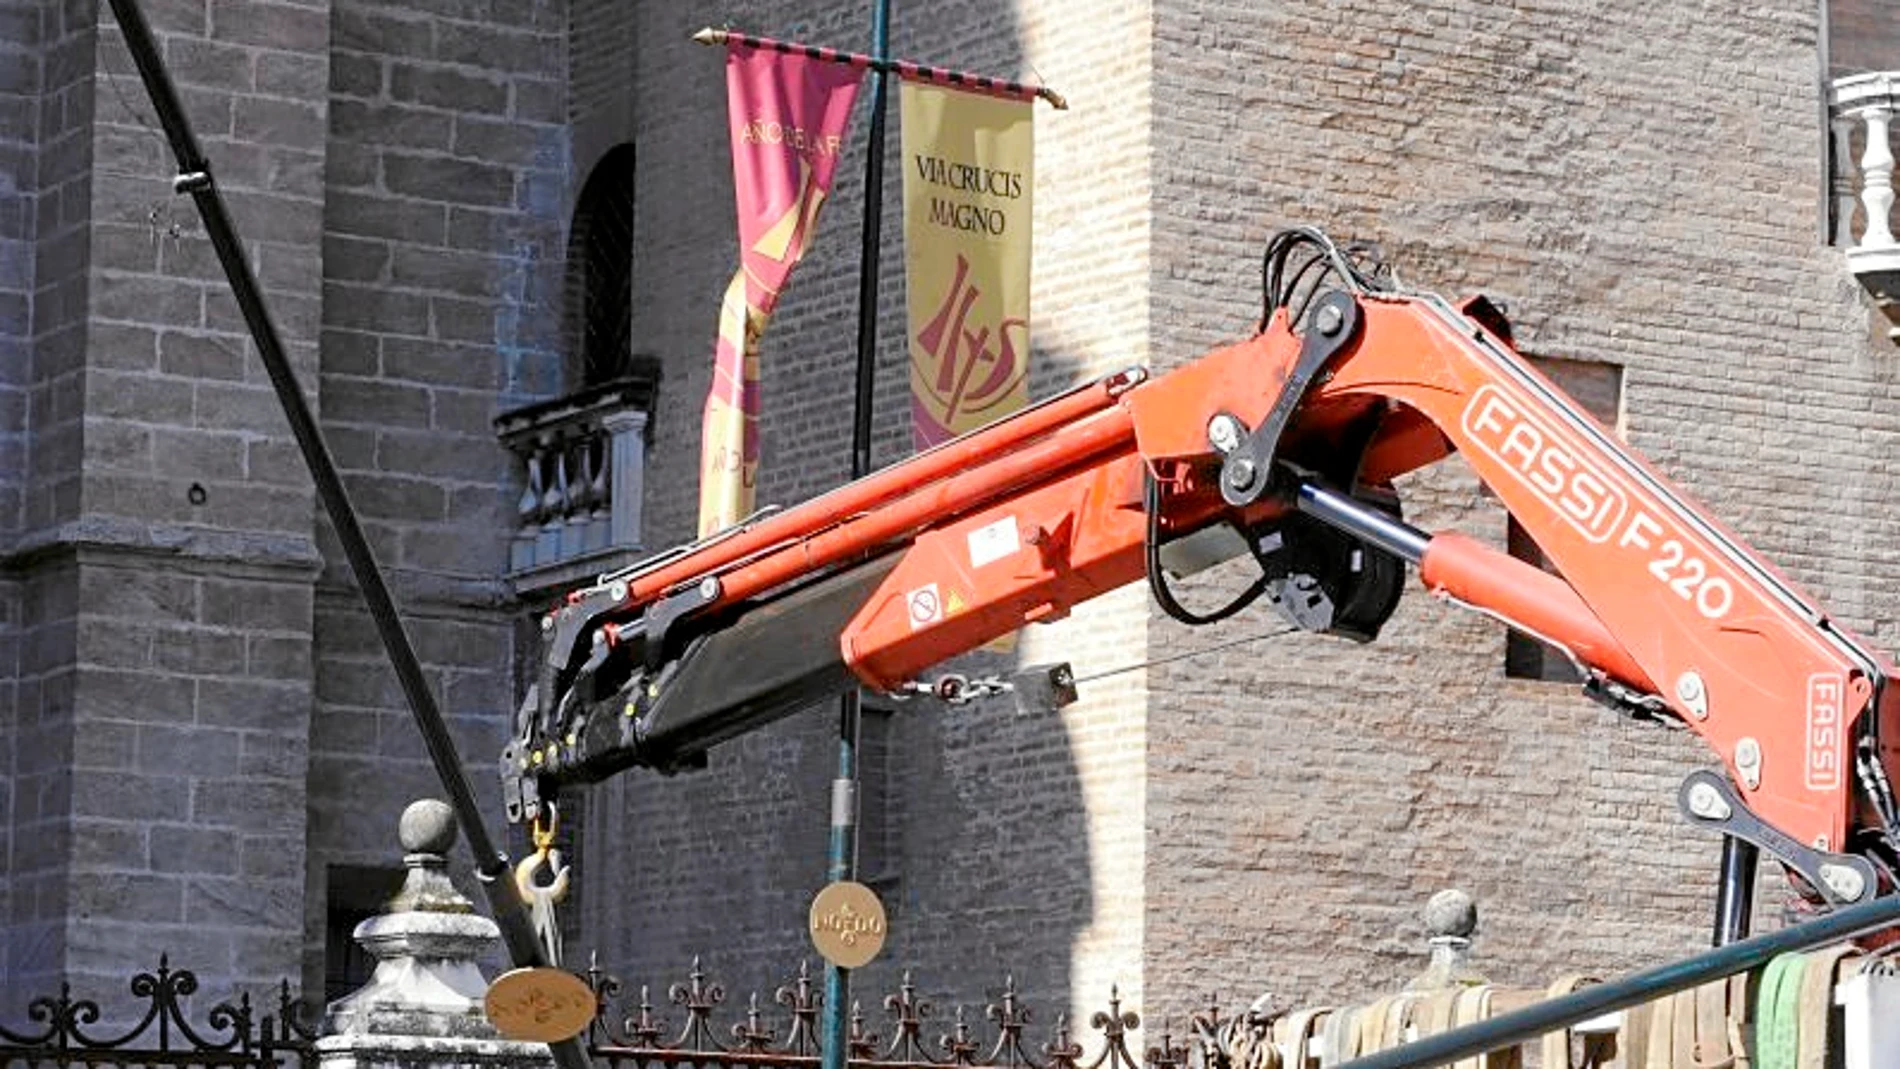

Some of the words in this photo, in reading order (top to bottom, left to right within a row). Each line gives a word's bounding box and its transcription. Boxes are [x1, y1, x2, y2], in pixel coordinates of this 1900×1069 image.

[740, 118, 782, 145] AÑO
[929, 197, 1005, 235] MAGNO
[1473, 397, 1614, 530] FASSI
[1620, 511, 1663, 550] F
[1647, 540, 1733, 618] 220
[1811, 683, 1836, 779] FASSI
